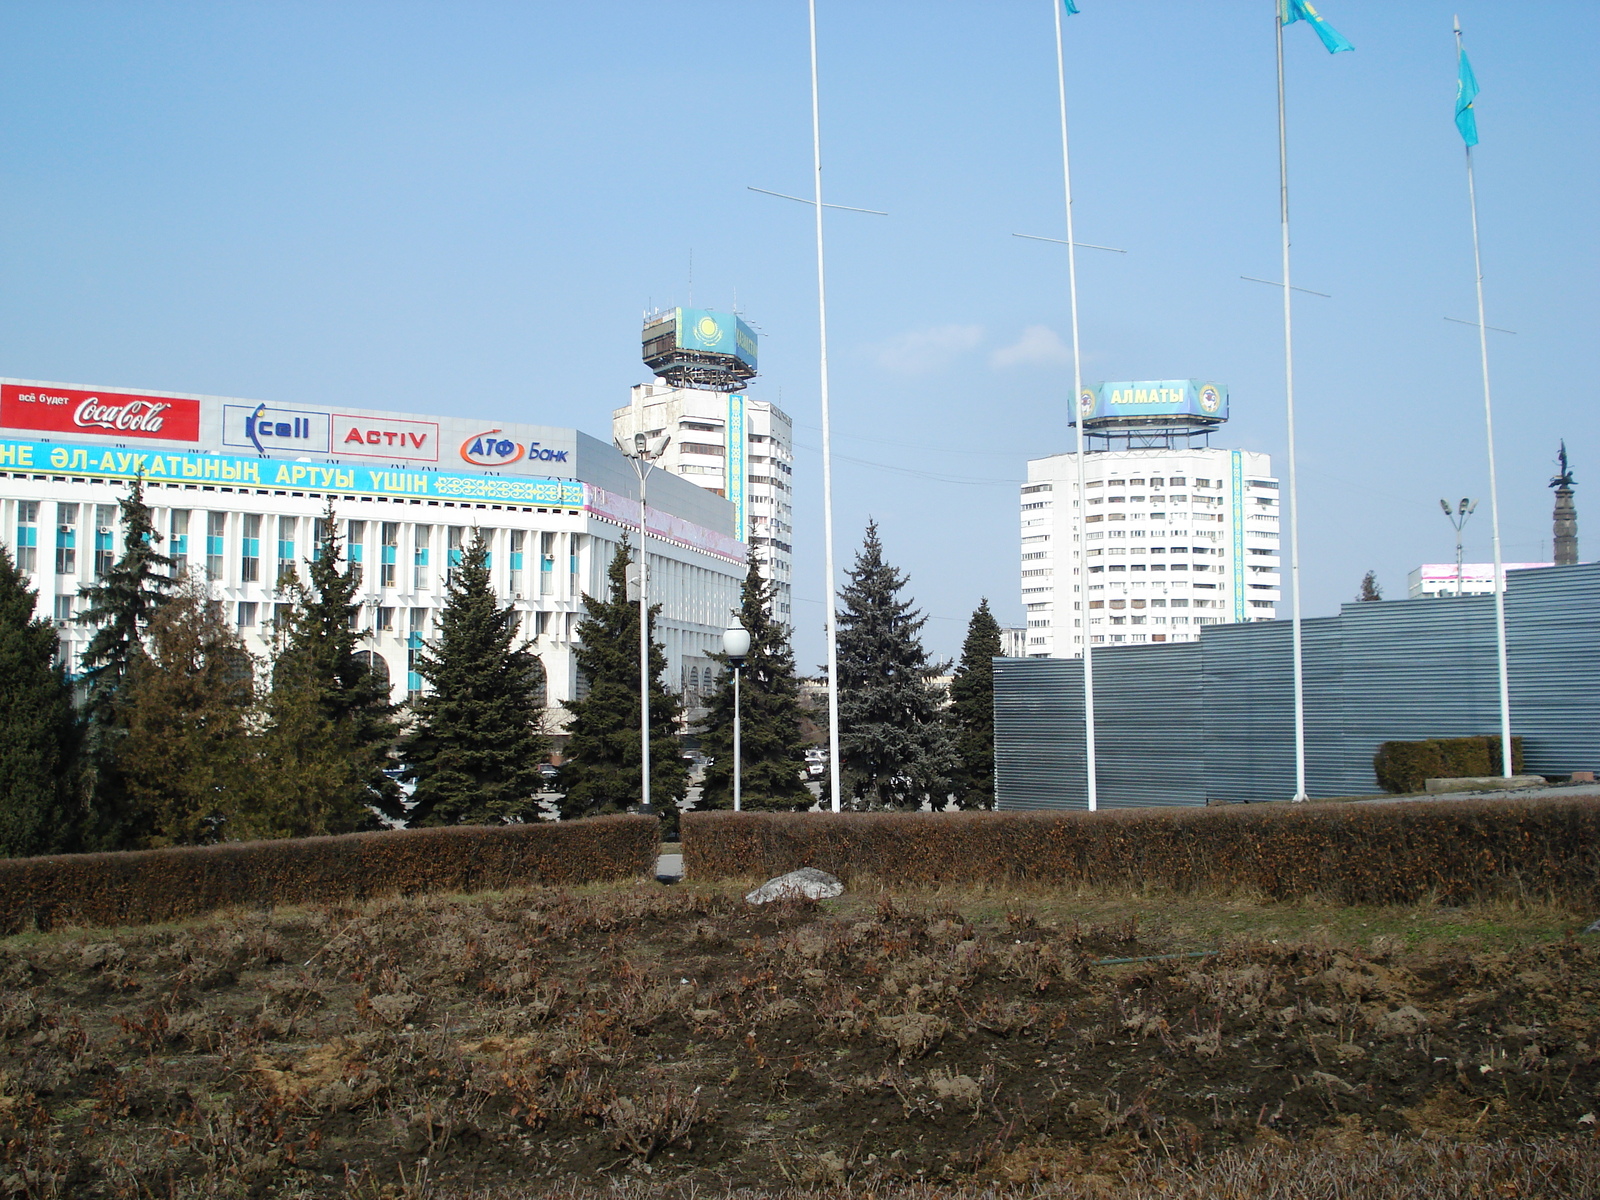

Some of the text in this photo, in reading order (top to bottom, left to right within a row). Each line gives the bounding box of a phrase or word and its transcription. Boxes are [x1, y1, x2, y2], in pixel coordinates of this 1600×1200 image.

[19, 393, 69, 405] всё будет
[1110, 388, 1184, 404] АЛМАТЫ
[73, 396, 170, 432] Coca-Cola
[468, 437, 568, 464] АТФ Банк
[276, 465, 354, 489] АРТУЫ
[370, 471, 428, 494] ҮШІН
